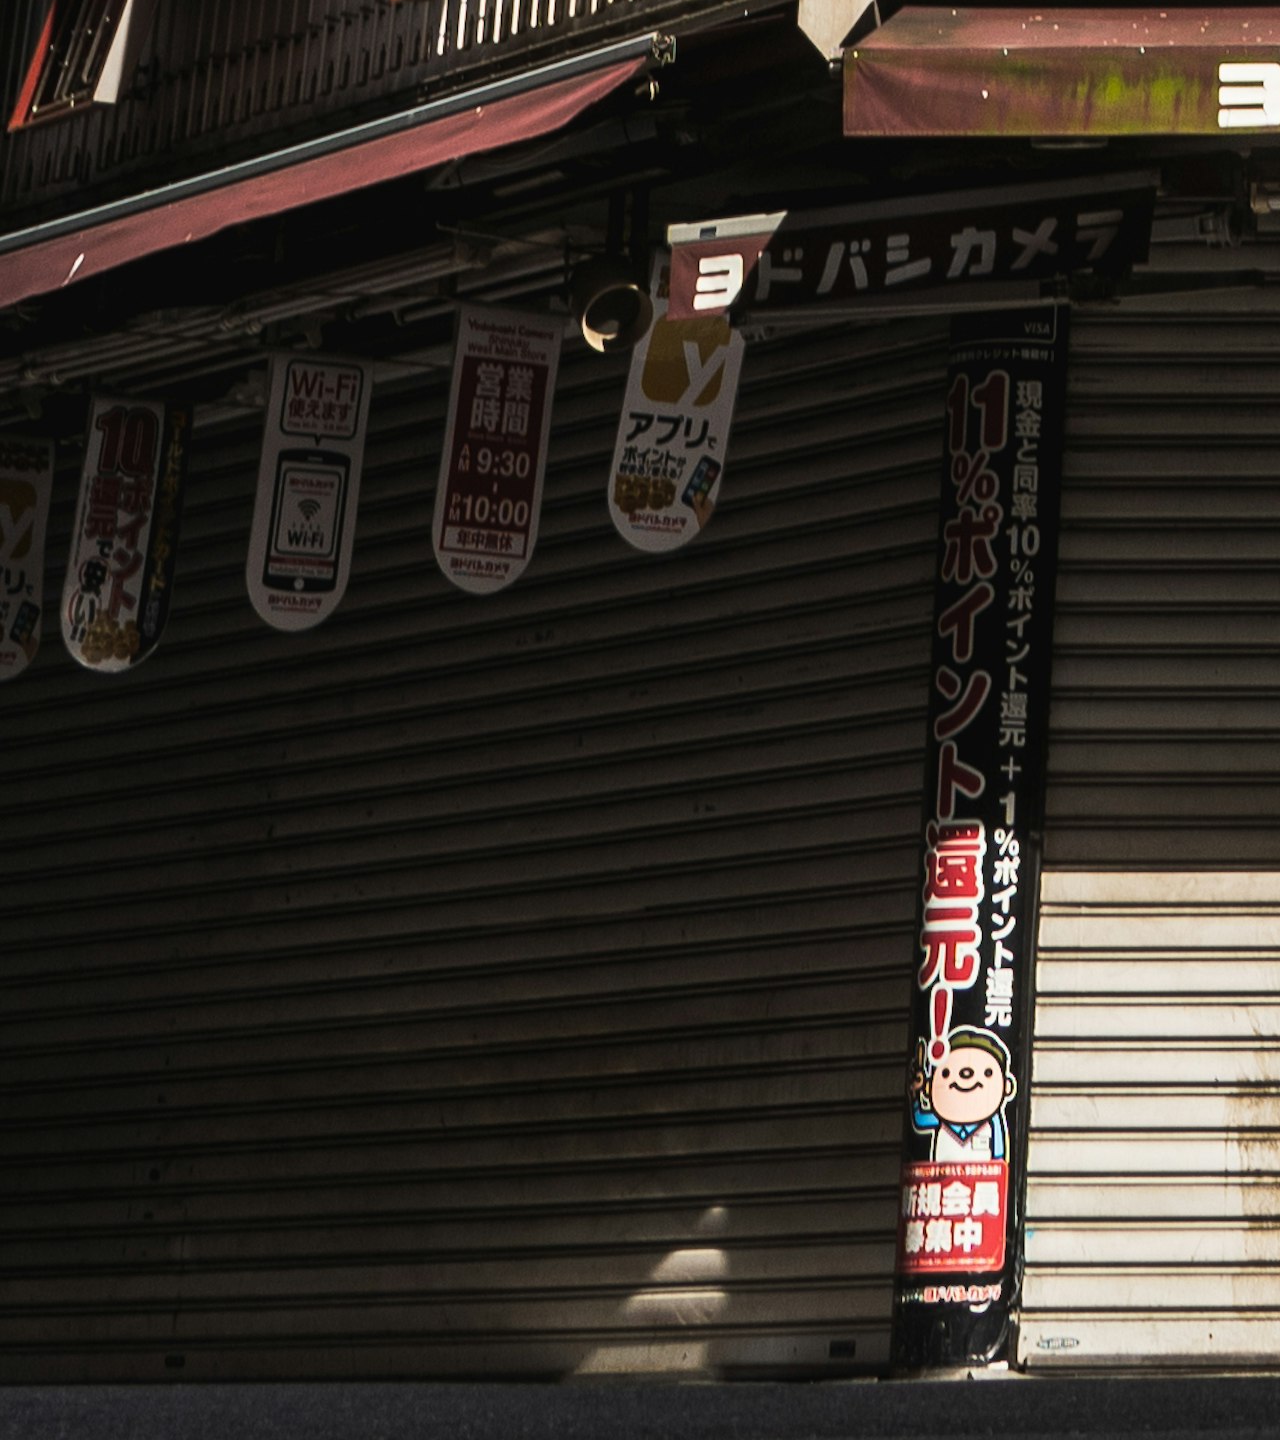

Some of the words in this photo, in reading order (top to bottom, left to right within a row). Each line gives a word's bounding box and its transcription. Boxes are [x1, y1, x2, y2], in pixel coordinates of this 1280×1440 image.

[691, 209, 1125, 312] ヨドバシカメラ
[1023, 321, 1051, 335] VISA
[291, 367, 359, 404] Wi-Fi
[475, 361, 535, 402] 営業
[287, 397, 353, 423] 使えます
[469, 396, 530, 437] 時間
[625, 411, 719, 450] アプリで
[476, 447, 531, 479] 9:30
[461, 495, 530, 528] 10:00
